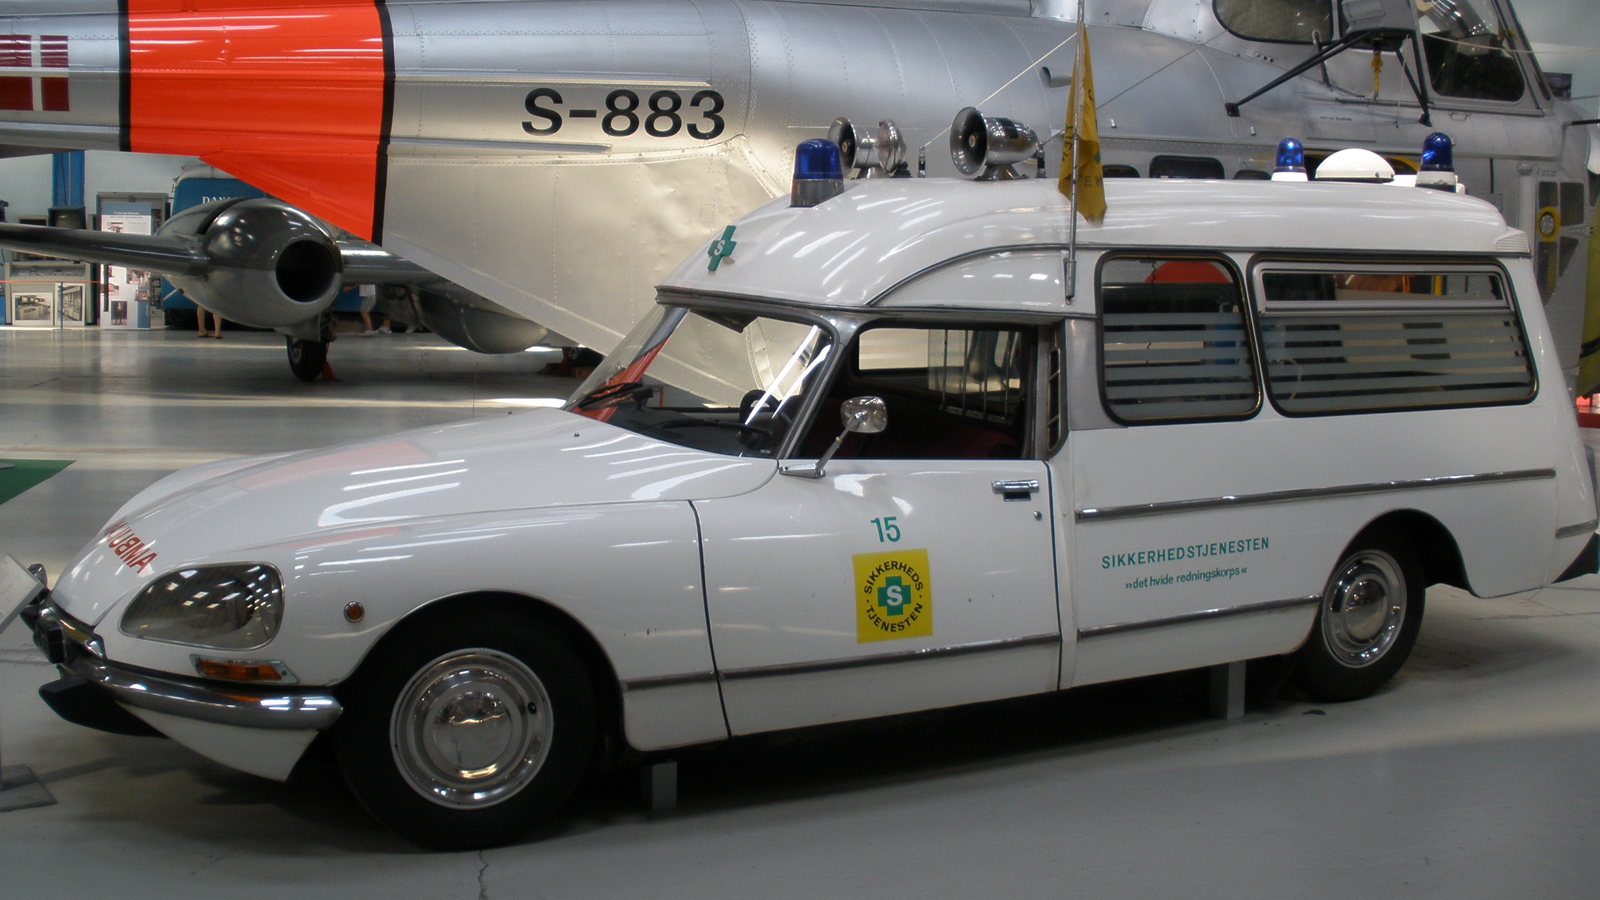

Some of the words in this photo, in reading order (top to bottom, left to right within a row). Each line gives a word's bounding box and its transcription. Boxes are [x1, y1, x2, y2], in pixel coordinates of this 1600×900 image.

[521, 87, 725, 140] S-883
[714, 239, 726, 256] S
[870, 516, 901, 543] 15
[1101, 537, 1269, 569] SIKKERHEDSTJENESTEN
[863, 560, 924, 595] SIKKERHEDS
[1149, 574, 1174, 587] hvide
[886, 585, 904, 607] S
[866, 602, 923, 633] TJENESTEN
